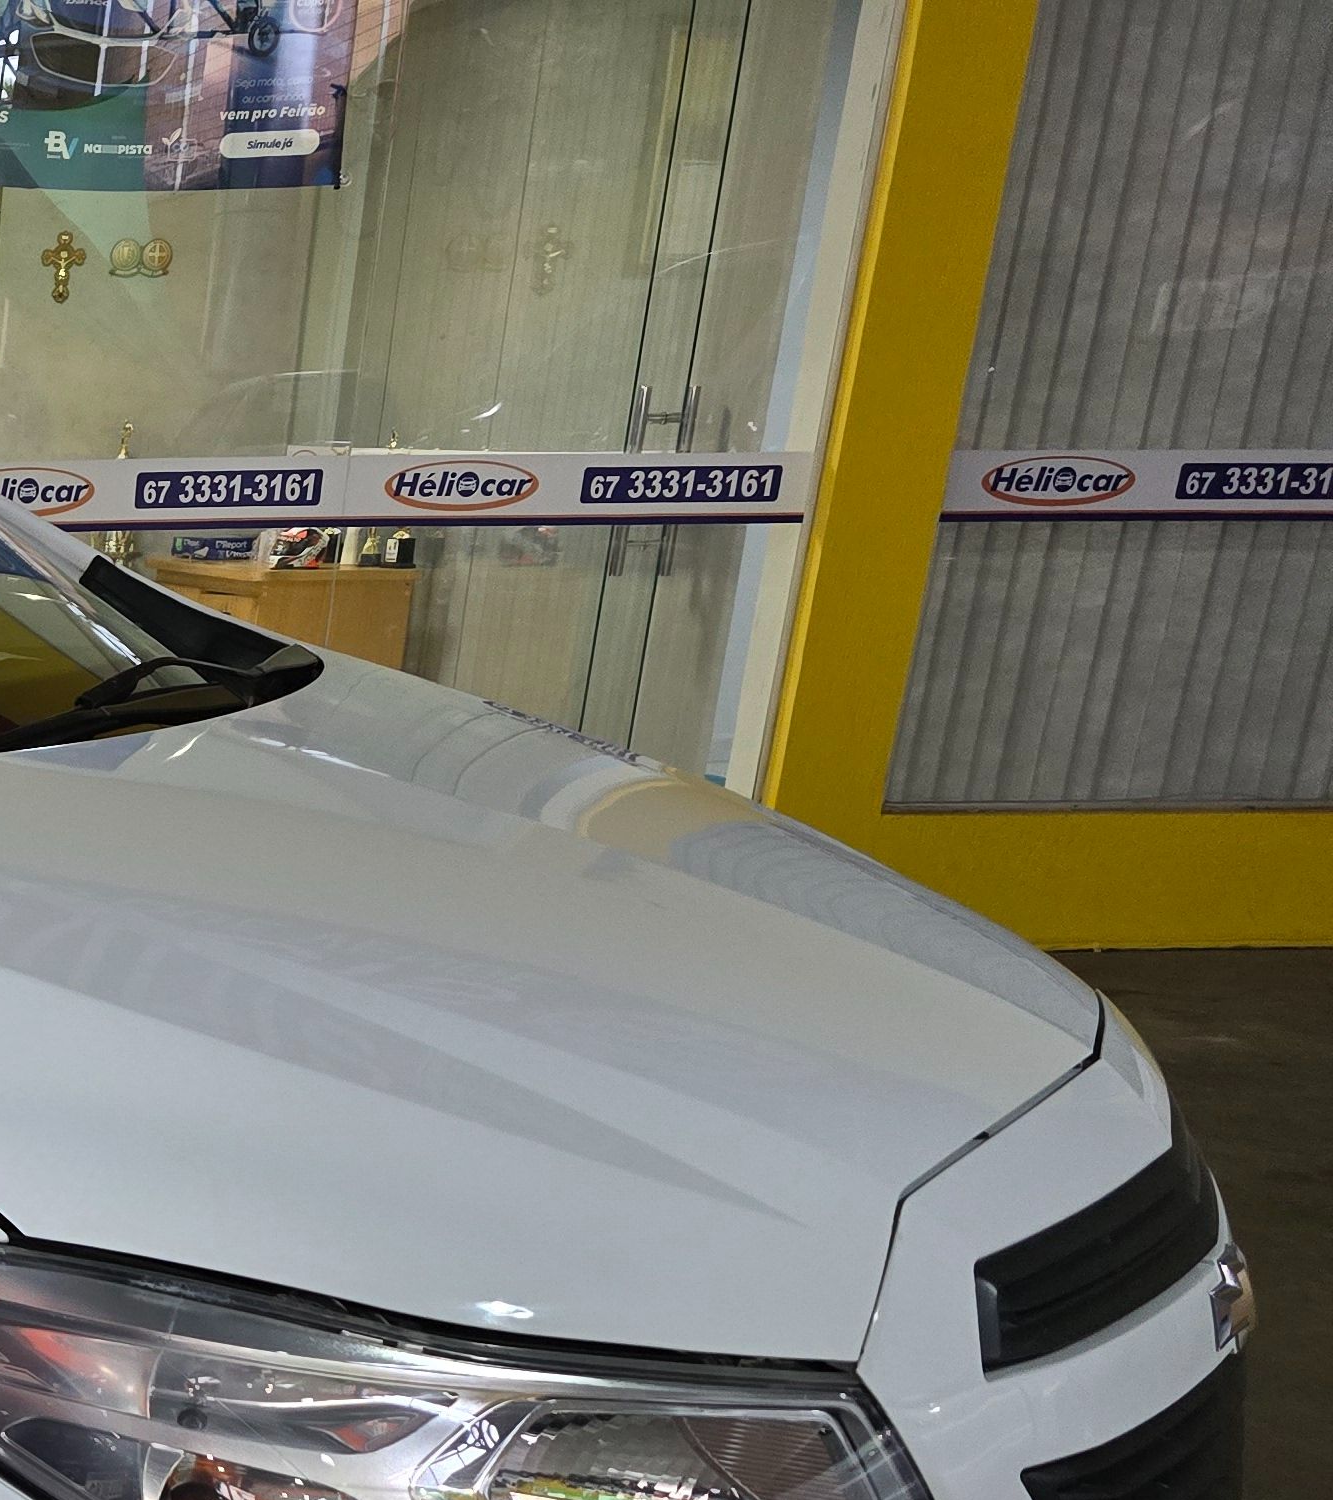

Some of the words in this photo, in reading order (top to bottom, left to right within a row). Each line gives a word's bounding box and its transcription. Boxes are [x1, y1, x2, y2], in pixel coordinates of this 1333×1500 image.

[219, 109, 250, 121] vem
[250, 108, 278, 123] pro
[279, 103, 327, 119] Feirão
[247, 138, 281, 150] Simule
[281, 137, 294, 151] já
[143, 480, 171, 504] 67
[179, 472, 317, 503] 3331-3161
[589, 474, 620, 500] 67
[628, 468, 775, 499] 3331-3161
[1185, 471, 1216, 495] 67
